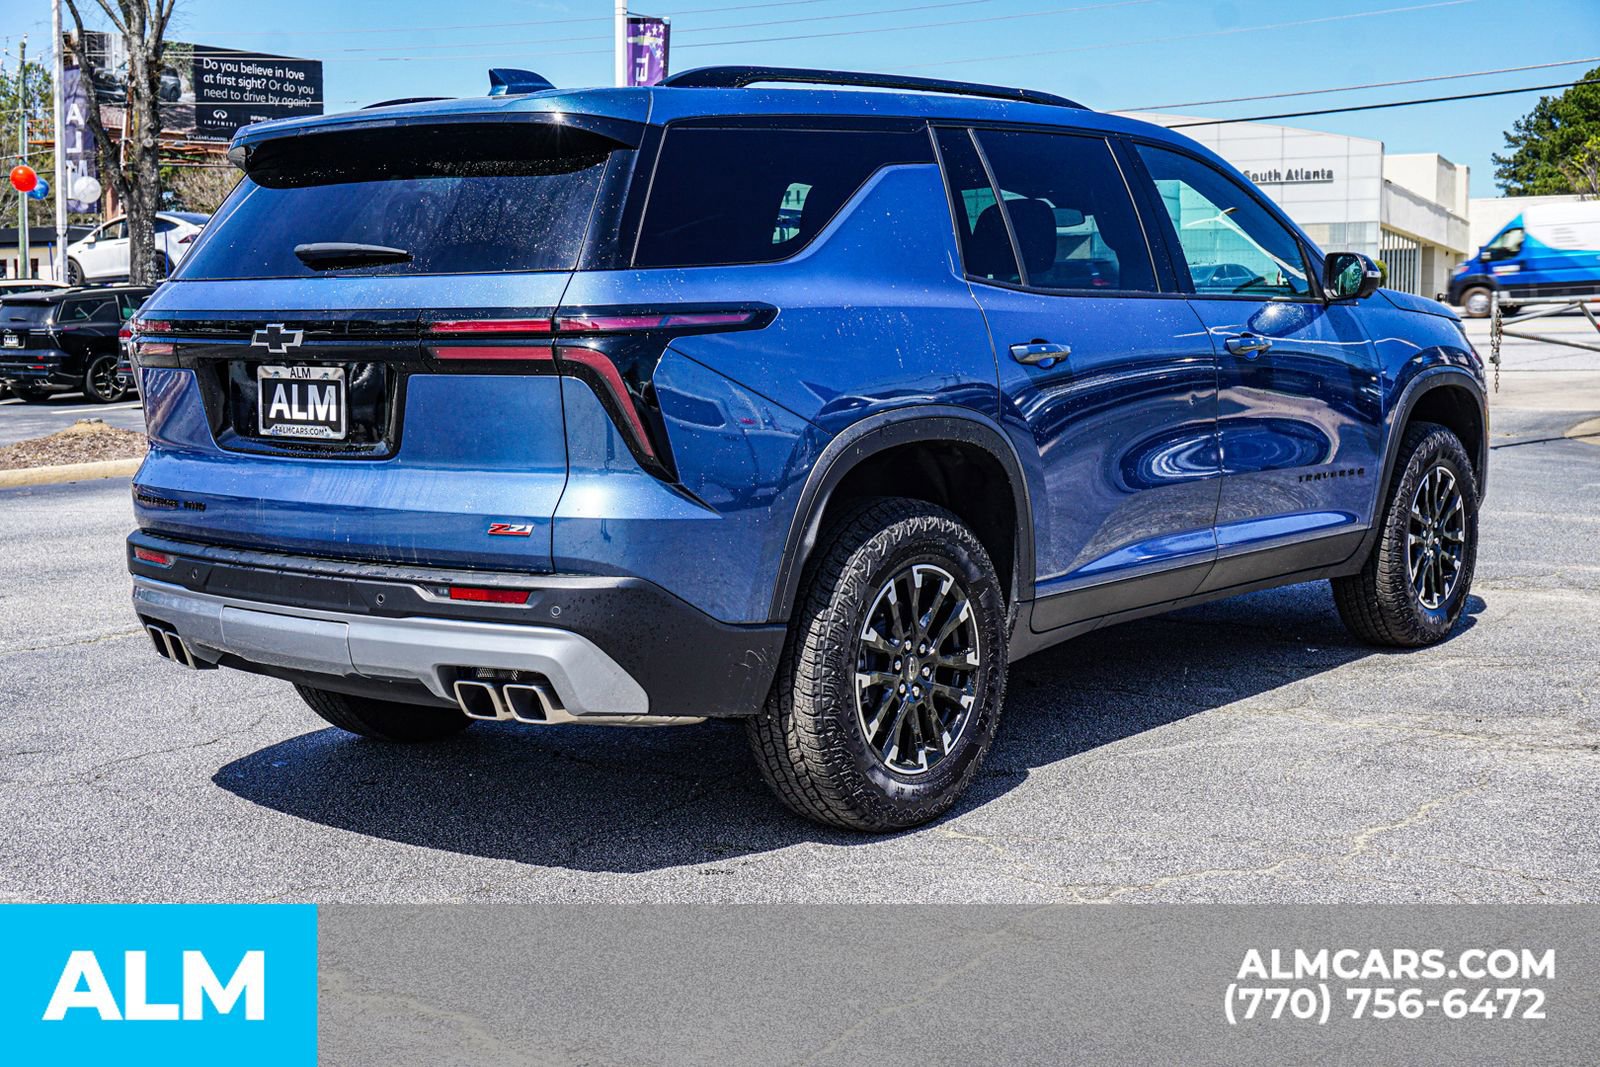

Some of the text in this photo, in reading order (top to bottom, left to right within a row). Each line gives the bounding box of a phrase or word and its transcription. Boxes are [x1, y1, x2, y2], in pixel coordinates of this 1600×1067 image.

[203, 58, 305, 81] Do you believe in love
[203, 74, 314, 96] at first sight? Or do you
[203, 88, 312, 109] need to drive by again?
[1243, 168, 1334, 182] South Atlanta
[290, 367, 311, 379] ALM
[269, 383, 337, 422] ALM
